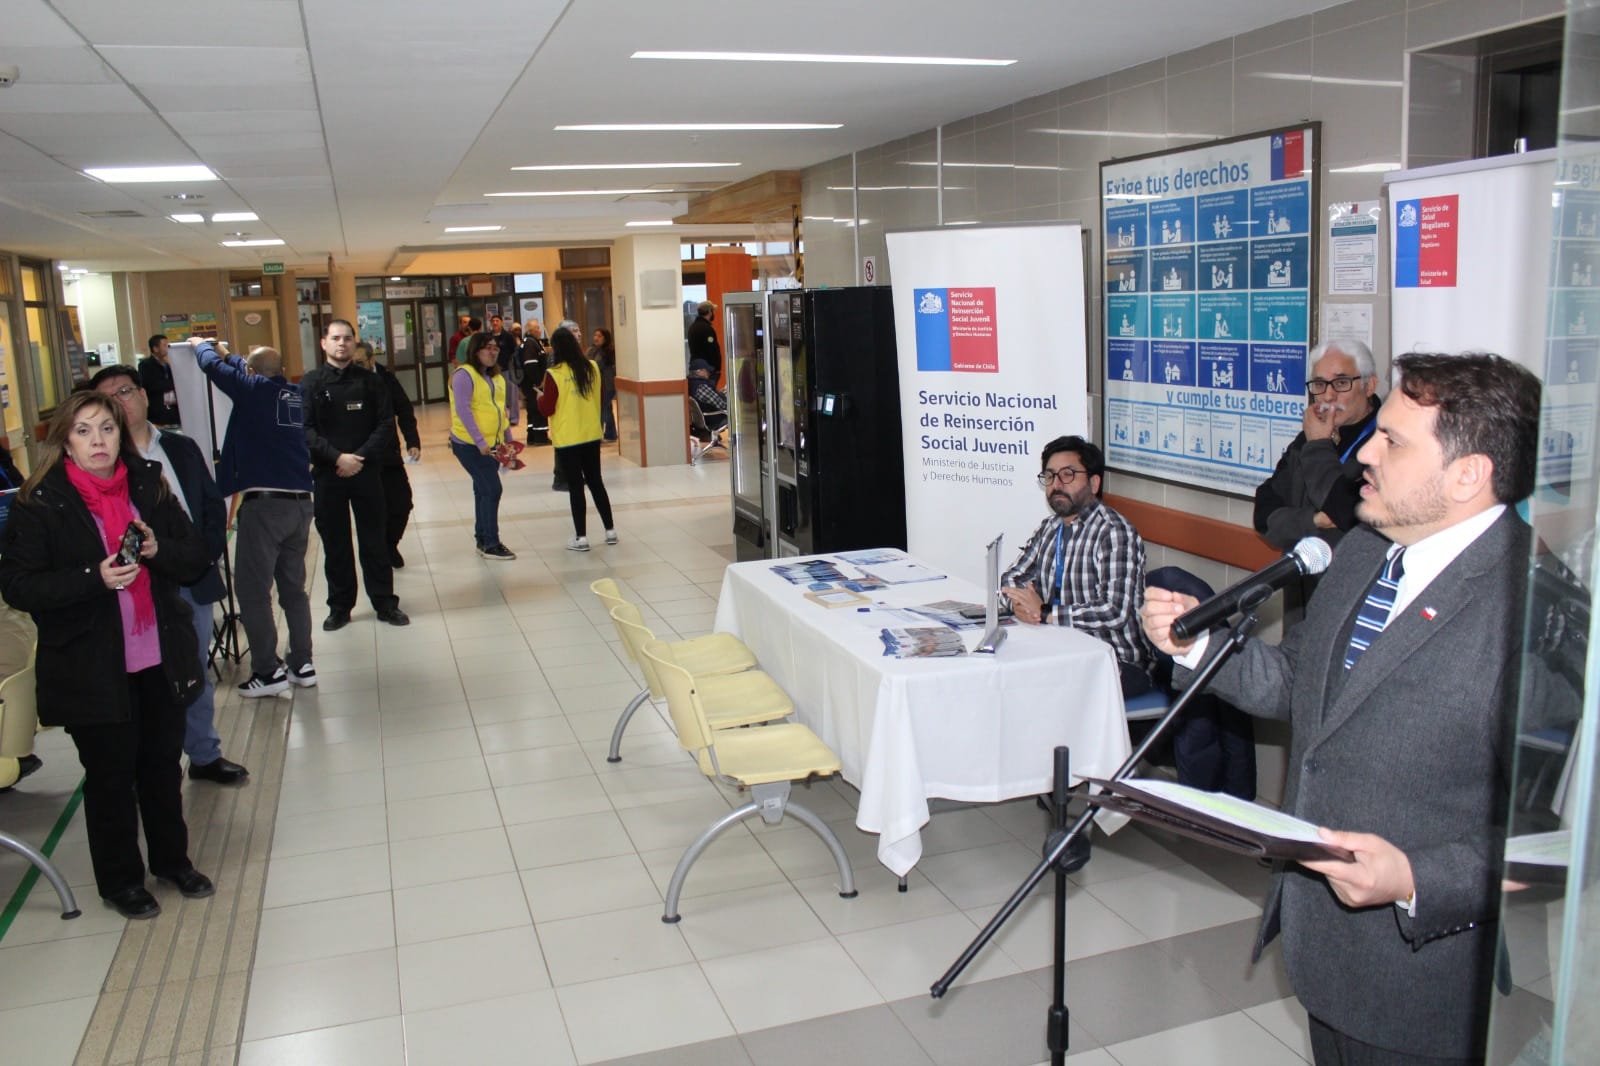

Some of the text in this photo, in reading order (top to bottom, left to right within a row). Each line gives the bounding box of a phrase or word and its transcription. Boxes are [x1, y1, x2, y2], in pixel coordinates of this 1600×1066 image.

[1106, 162, 1249, 204] Exige tus derechos
[1421, 213, 1436, 221] Salud
[1421, 221, 1450, 231] Magallanes
[918, 390, 1058, 410] Servicio Nacional
[1176, 390, 1221, 409] cumple
[1224, 392, 1246, 410] tus
[1250, 393, 1305, 417] deberes
[920, 413, 1035, 432] de Reinserción
[921, 435, 1030, 455] Social Juvenil
[922, 457, 1015, 472] Ministerio de Justicia
[922, 471, 1013, 487] y Derechos Humanos
